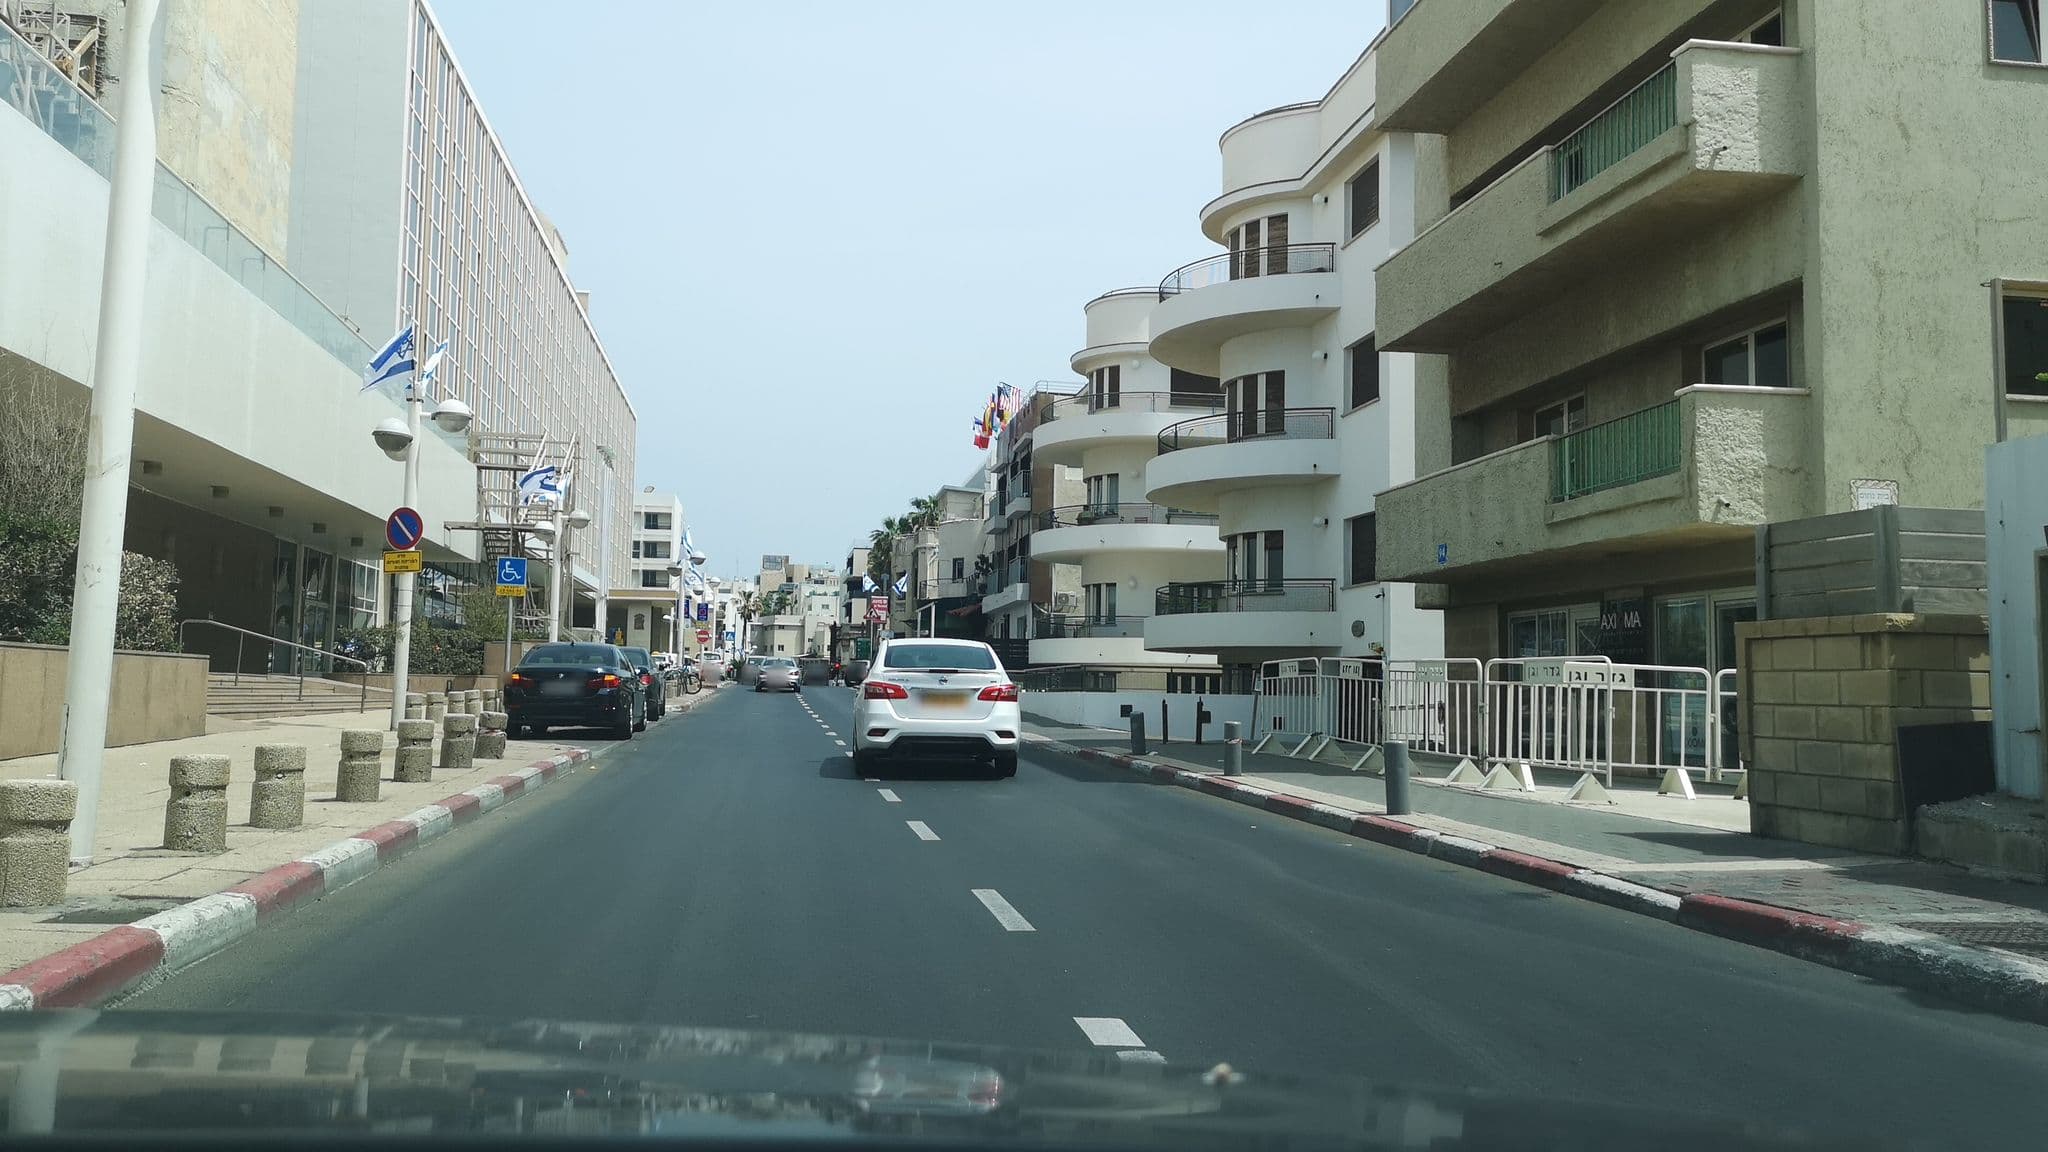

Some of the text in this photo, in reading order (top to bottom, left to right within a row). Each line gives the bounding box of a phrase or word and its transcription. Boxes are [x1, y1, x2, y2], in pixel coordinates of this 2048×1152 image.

[1527, 665, 1561, 680] גדר וגן
[1568, 670, 1588, 683] וגן
